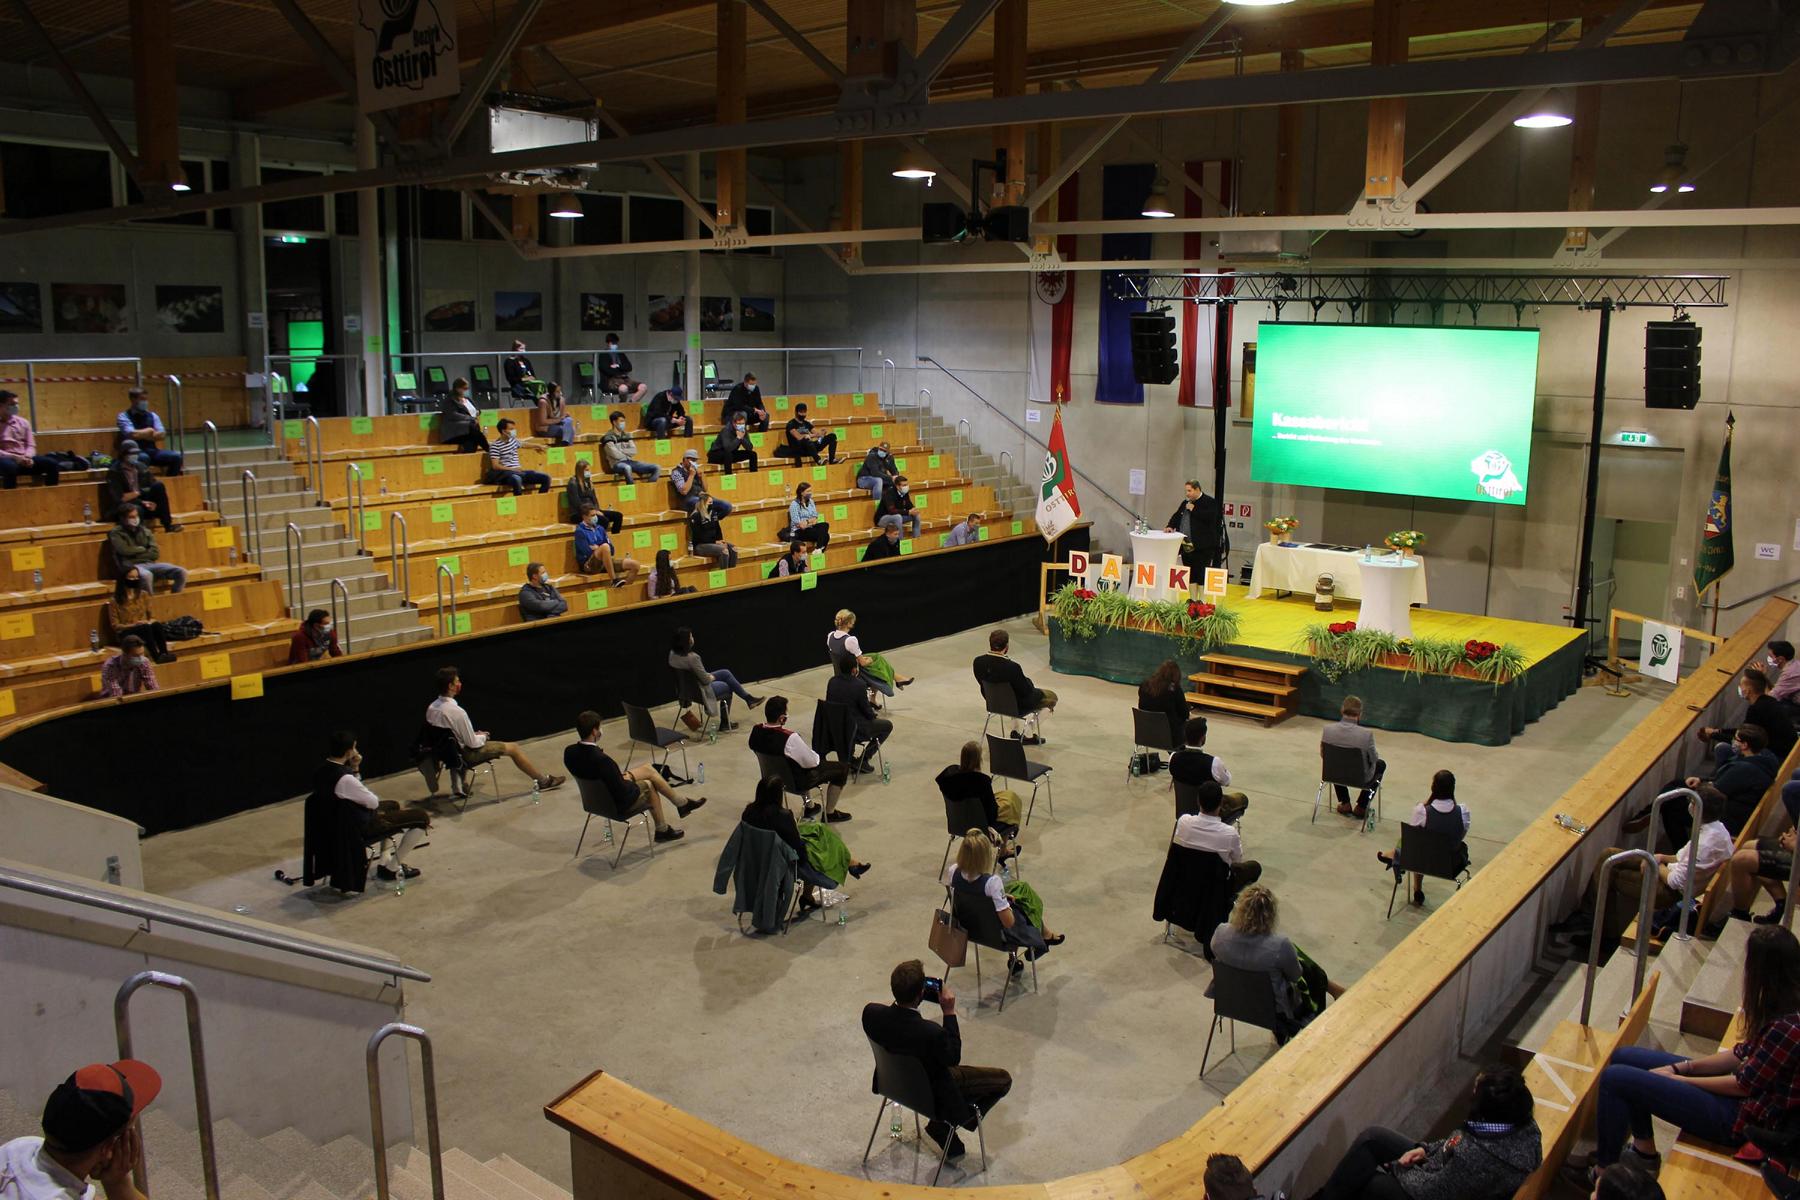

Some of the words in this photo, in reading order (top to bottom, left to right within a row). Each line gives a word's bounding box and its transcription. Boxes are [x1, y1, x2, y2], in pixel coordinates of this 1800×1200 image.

[372, 44, 436, 89] Osttirol
[1475, 483, 1513, 497] Osttirol
[1760, 546, 1775, 554] WC
[1071, 554, 1224, 593] DANKE
